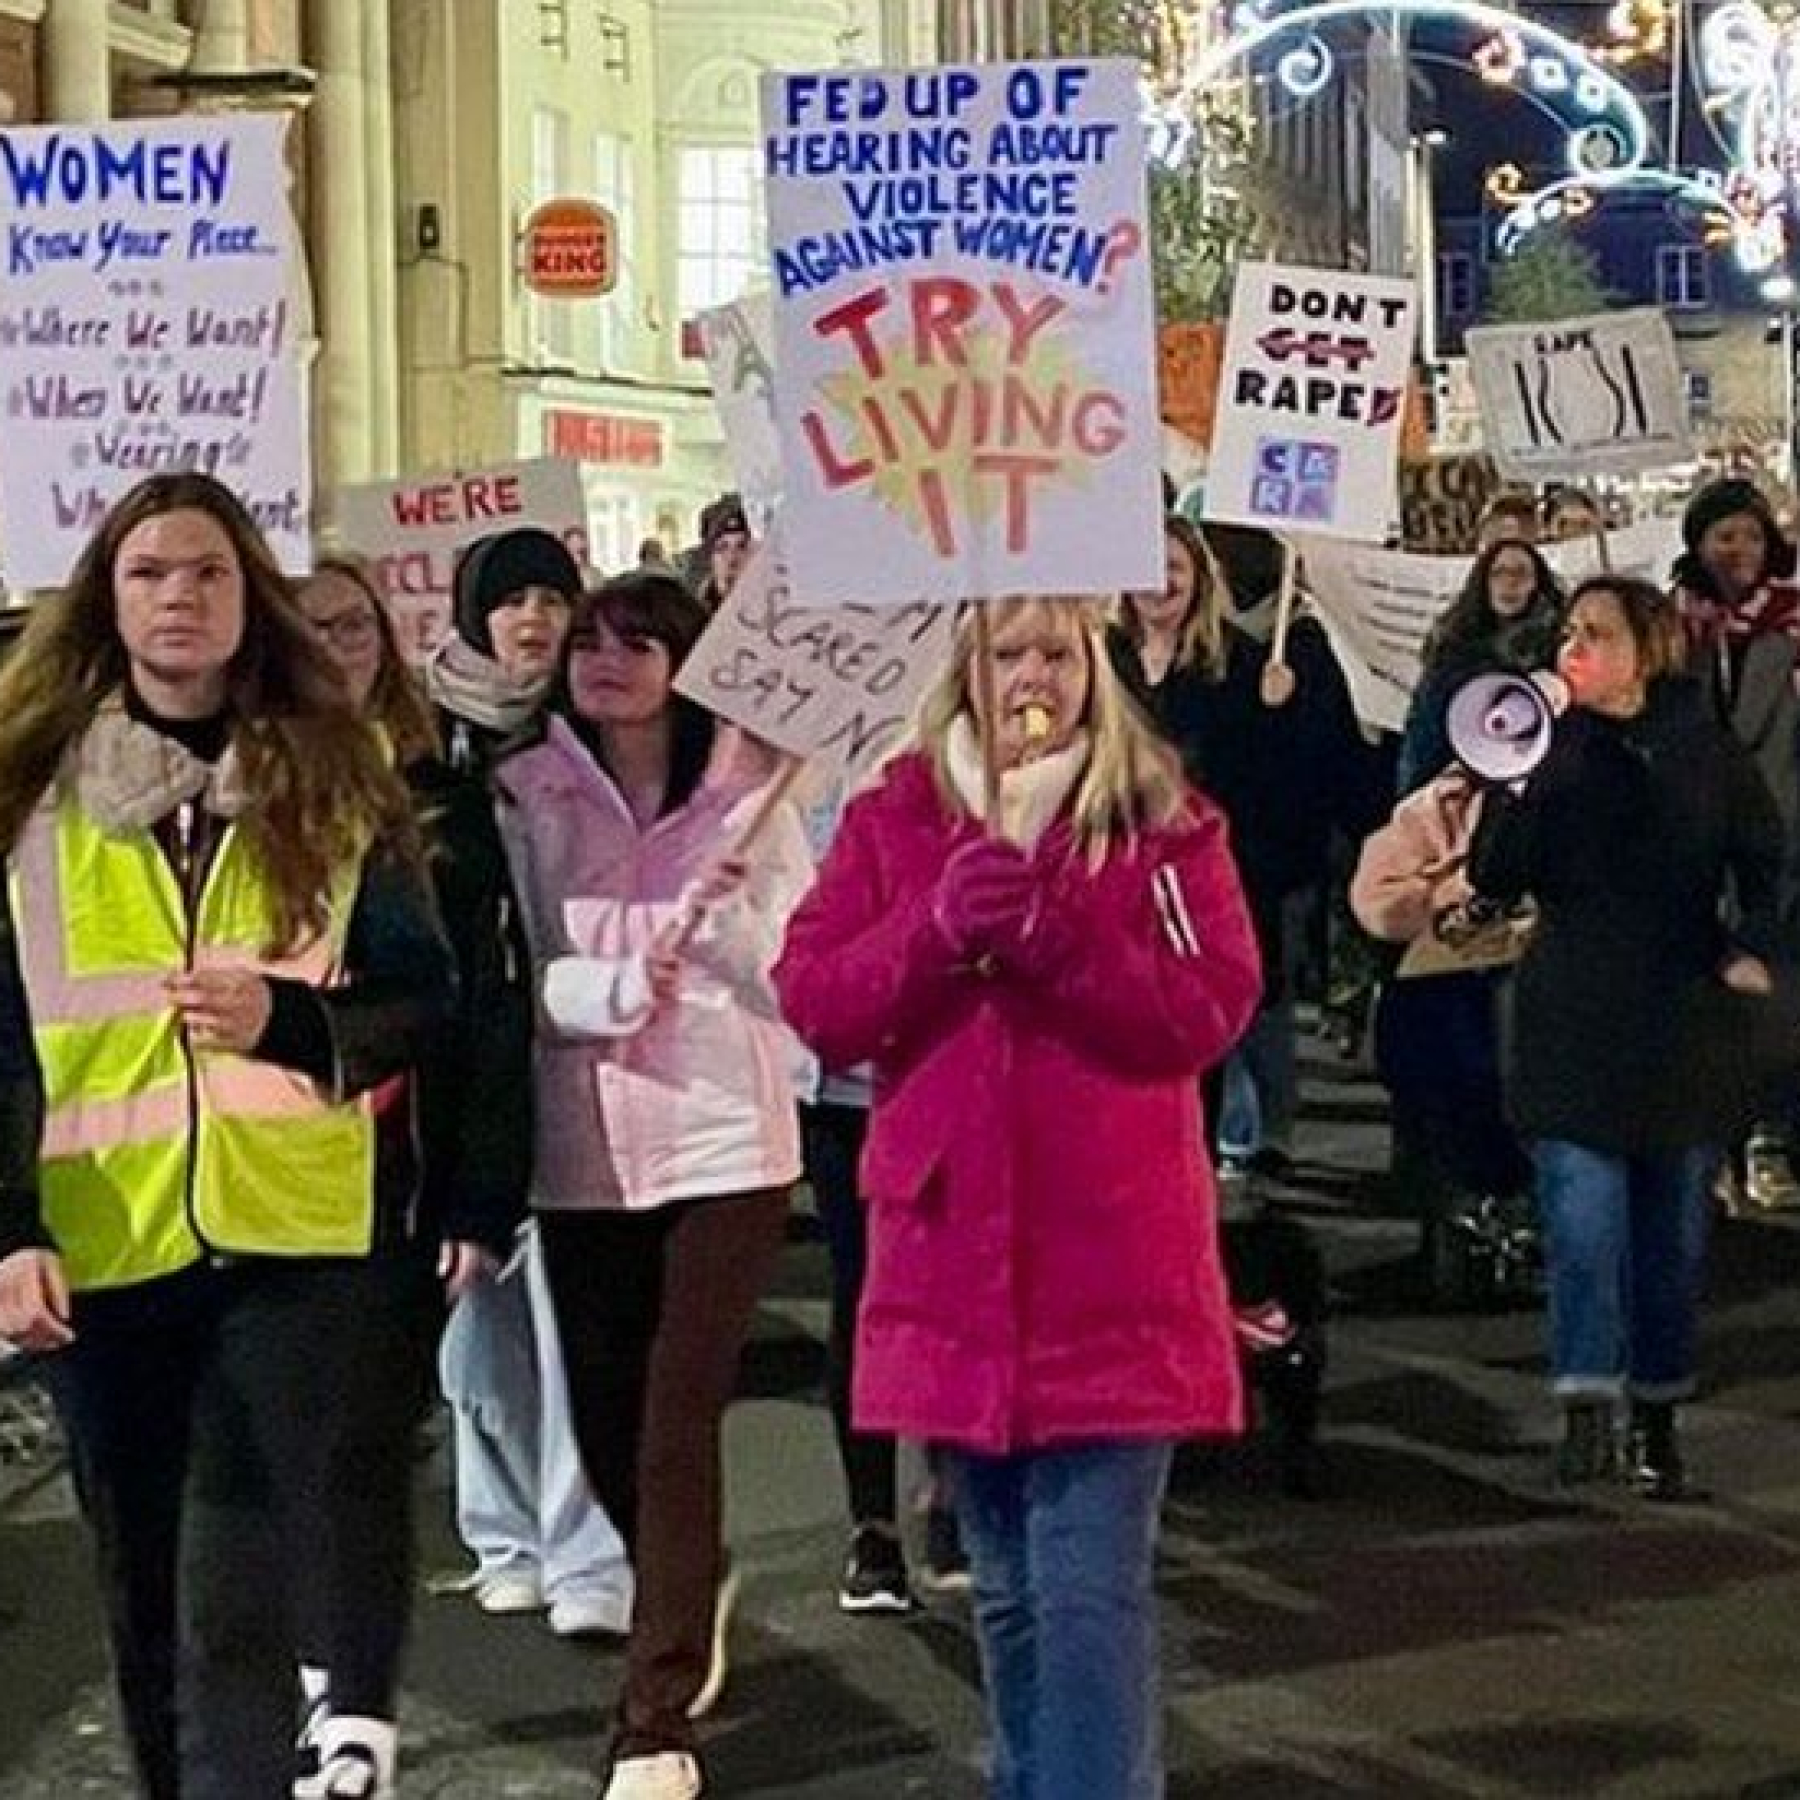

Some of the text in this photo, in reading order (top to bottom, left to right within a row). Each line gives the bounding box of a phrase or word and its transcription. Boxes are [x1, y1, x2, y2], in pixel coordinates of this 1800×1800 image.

[786, 68, 1089, 126] FED UP OF
[0, 134, 229, 208] WOMEN
[767, 123, 1118, 175] HEARING ABOUT
[843, 173, 1077, 220] VIOLENCE
[9, 223, 88, 275] Know
[92, 220, 171, 272] Your
[774, 218, 1141, 296] AGAINST WOMEN?
[814, 278, 1067, 380] TRY
[802, 376, 1128, 489] LIVING
[918, 453, 1060, 557] IT
